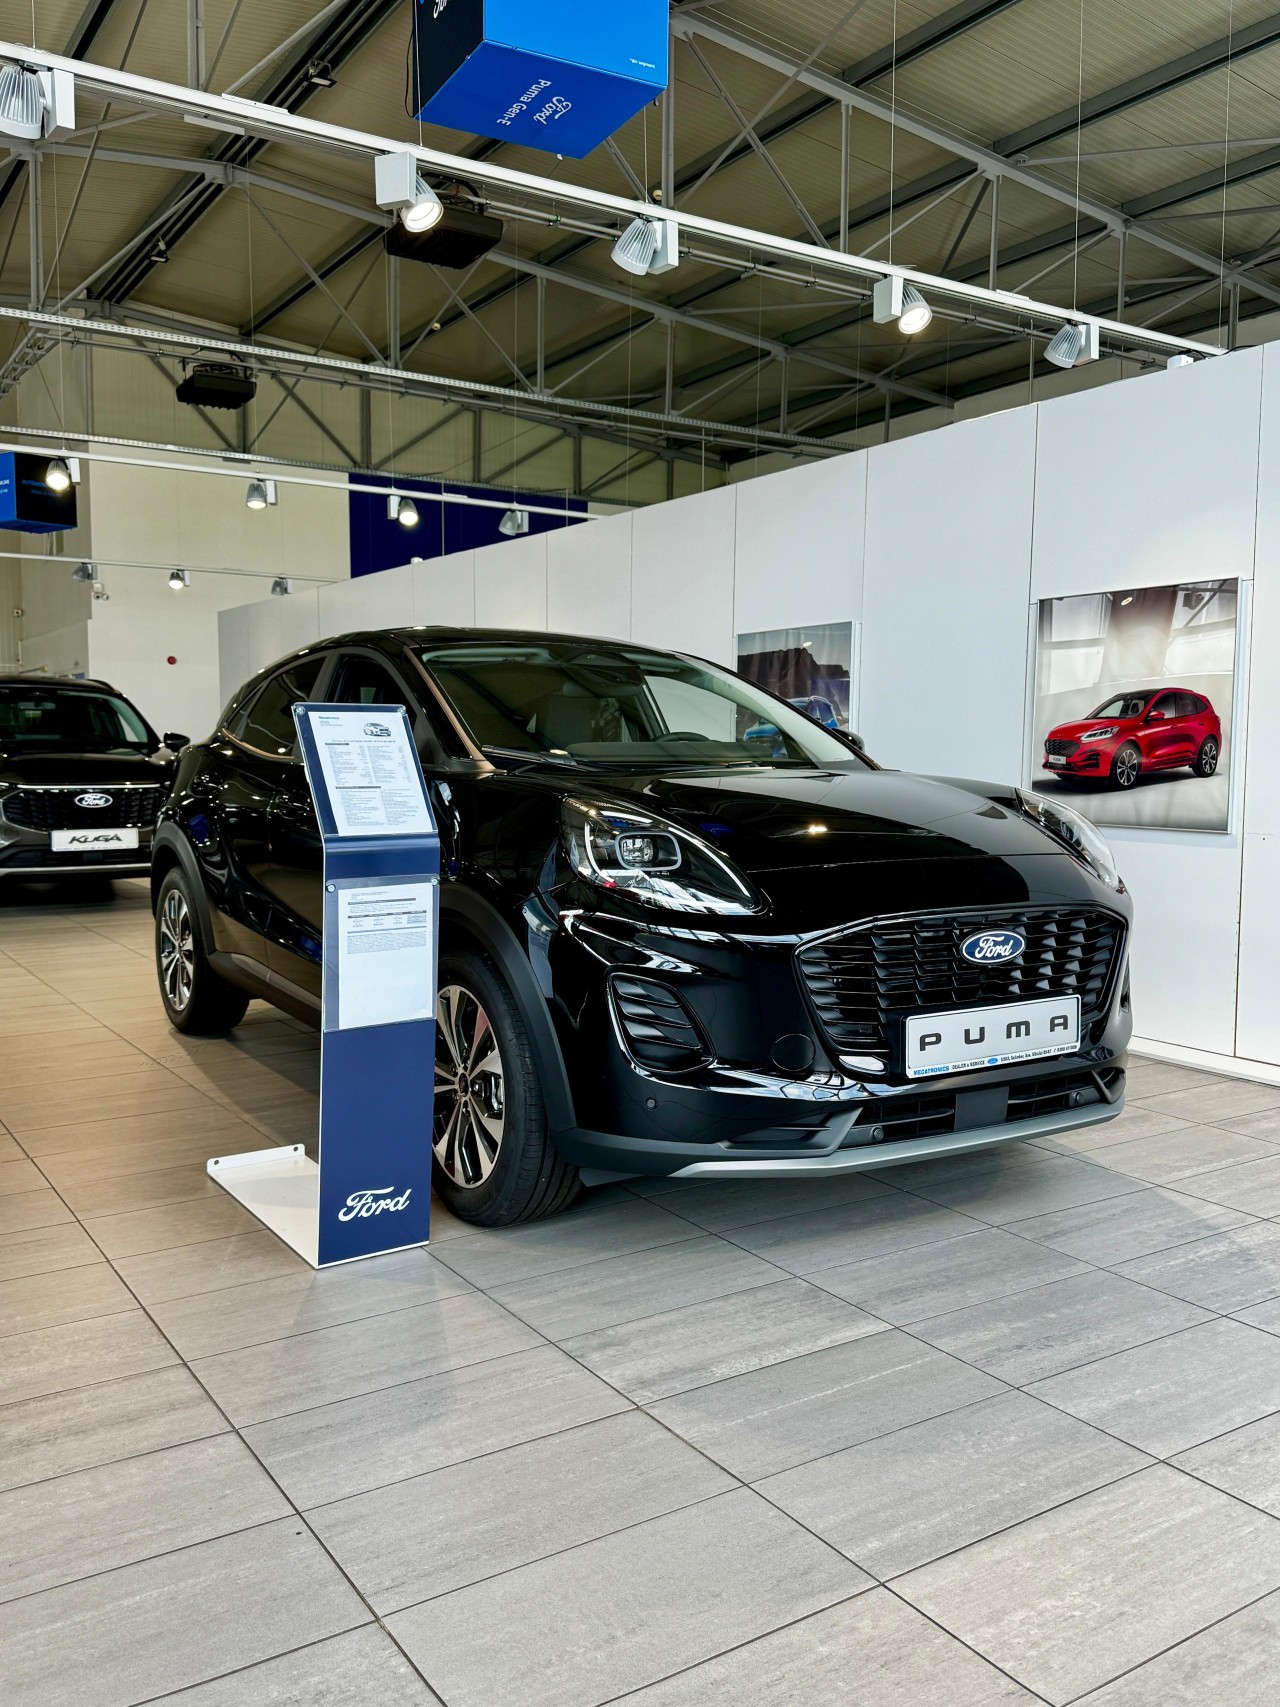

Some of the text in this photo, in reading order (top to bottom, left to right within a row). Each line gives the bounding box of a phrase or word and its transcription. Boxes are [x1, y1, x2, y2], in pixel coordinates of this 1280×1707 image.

[496, 78, 552, 126] Puma Gen-E
[533, 96, 572, 125] Ford
[68, 834, 123, 844] KUGA
[974, 935, 1014, 959] Ford
[919, 1014, 1069, 1052] PUMA
[338, 1186, 412, 1222] Ford
